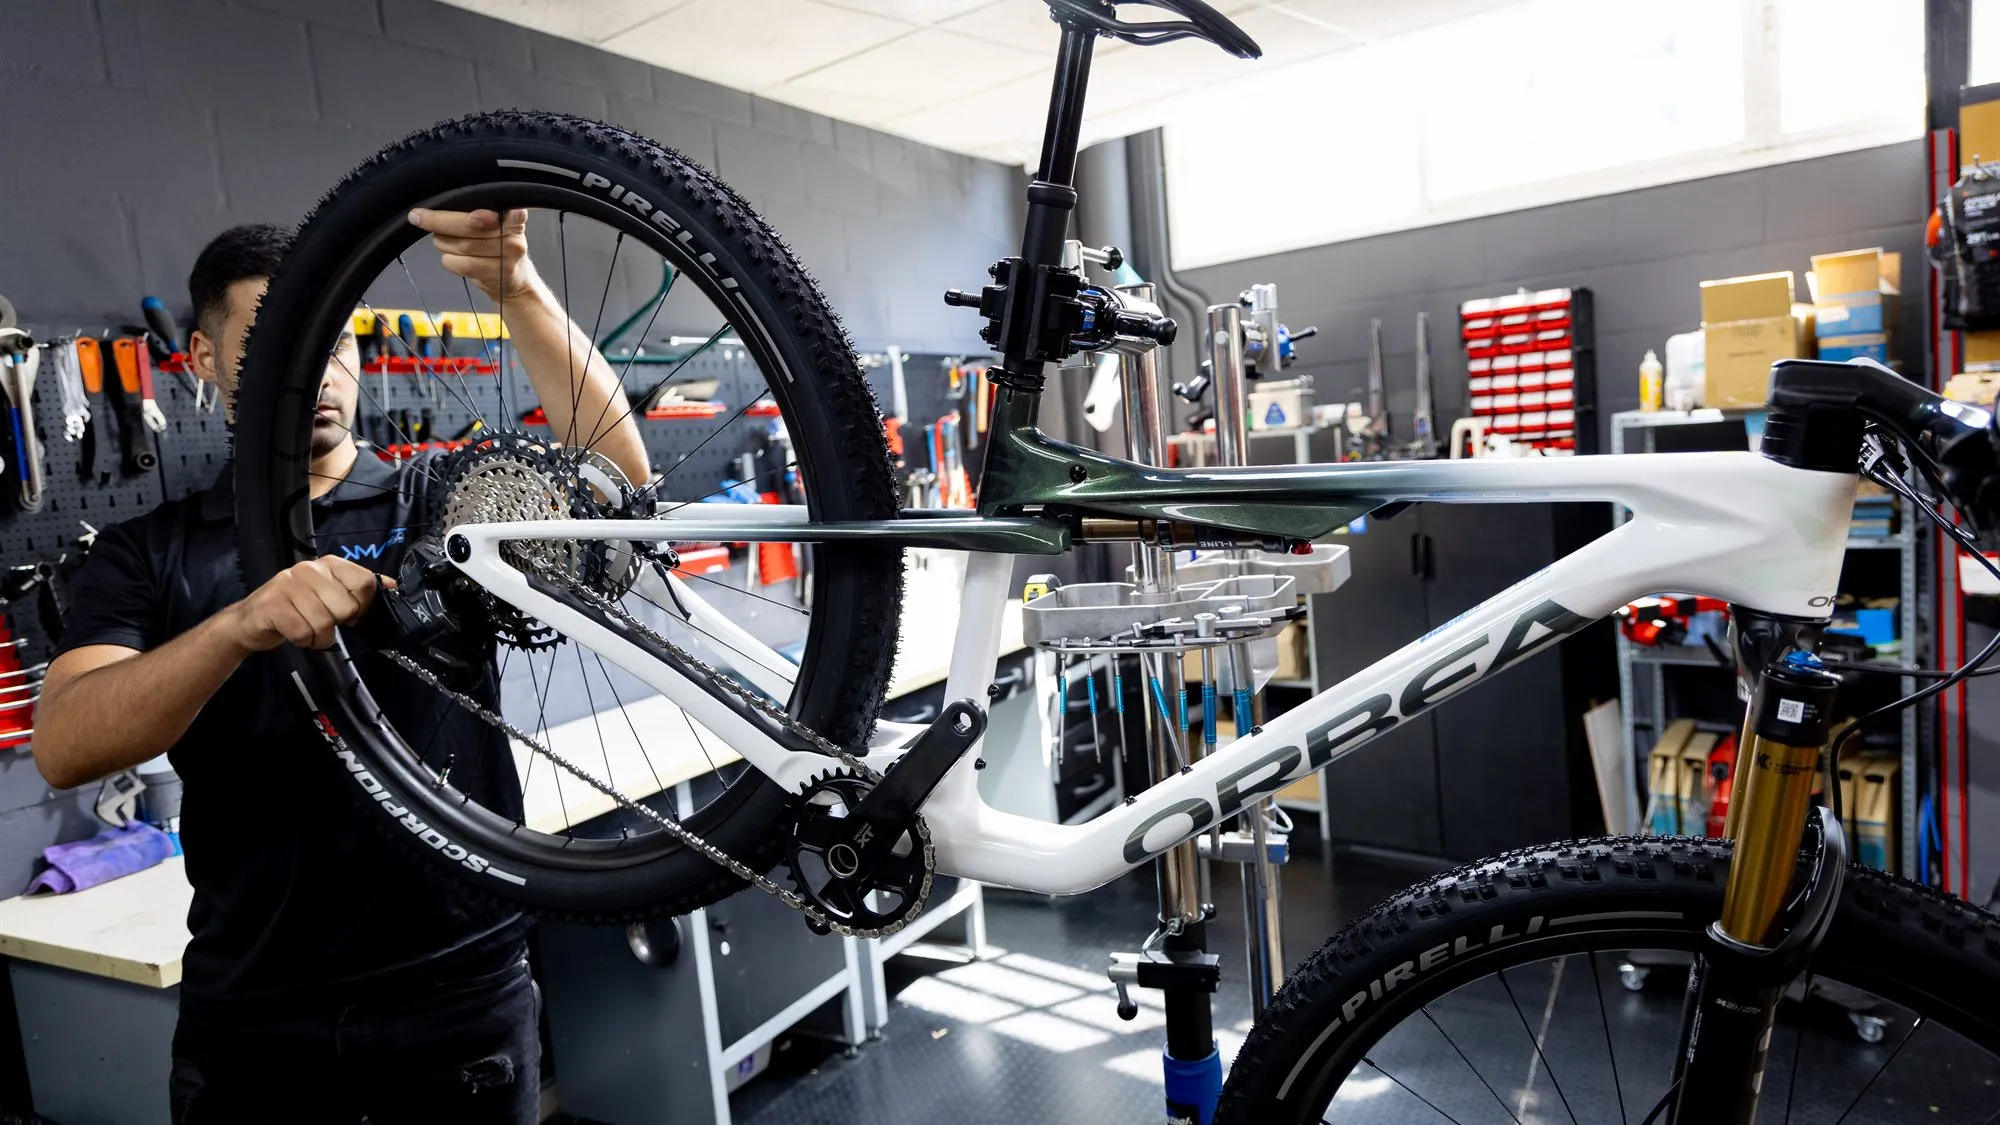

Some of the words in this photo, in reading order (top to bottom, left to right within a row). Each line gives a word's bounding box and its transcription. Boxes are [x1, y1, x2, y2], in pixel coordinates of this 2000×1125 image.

[582, 172, 739, 289] PIRELLI
[1123, 599, 1595, 864] ORBEA
[336, 750, 489, 873] SCORPION
[856, 825, 874, 849] XT
[1341, 915, 1544, 1022] PIRELLI
